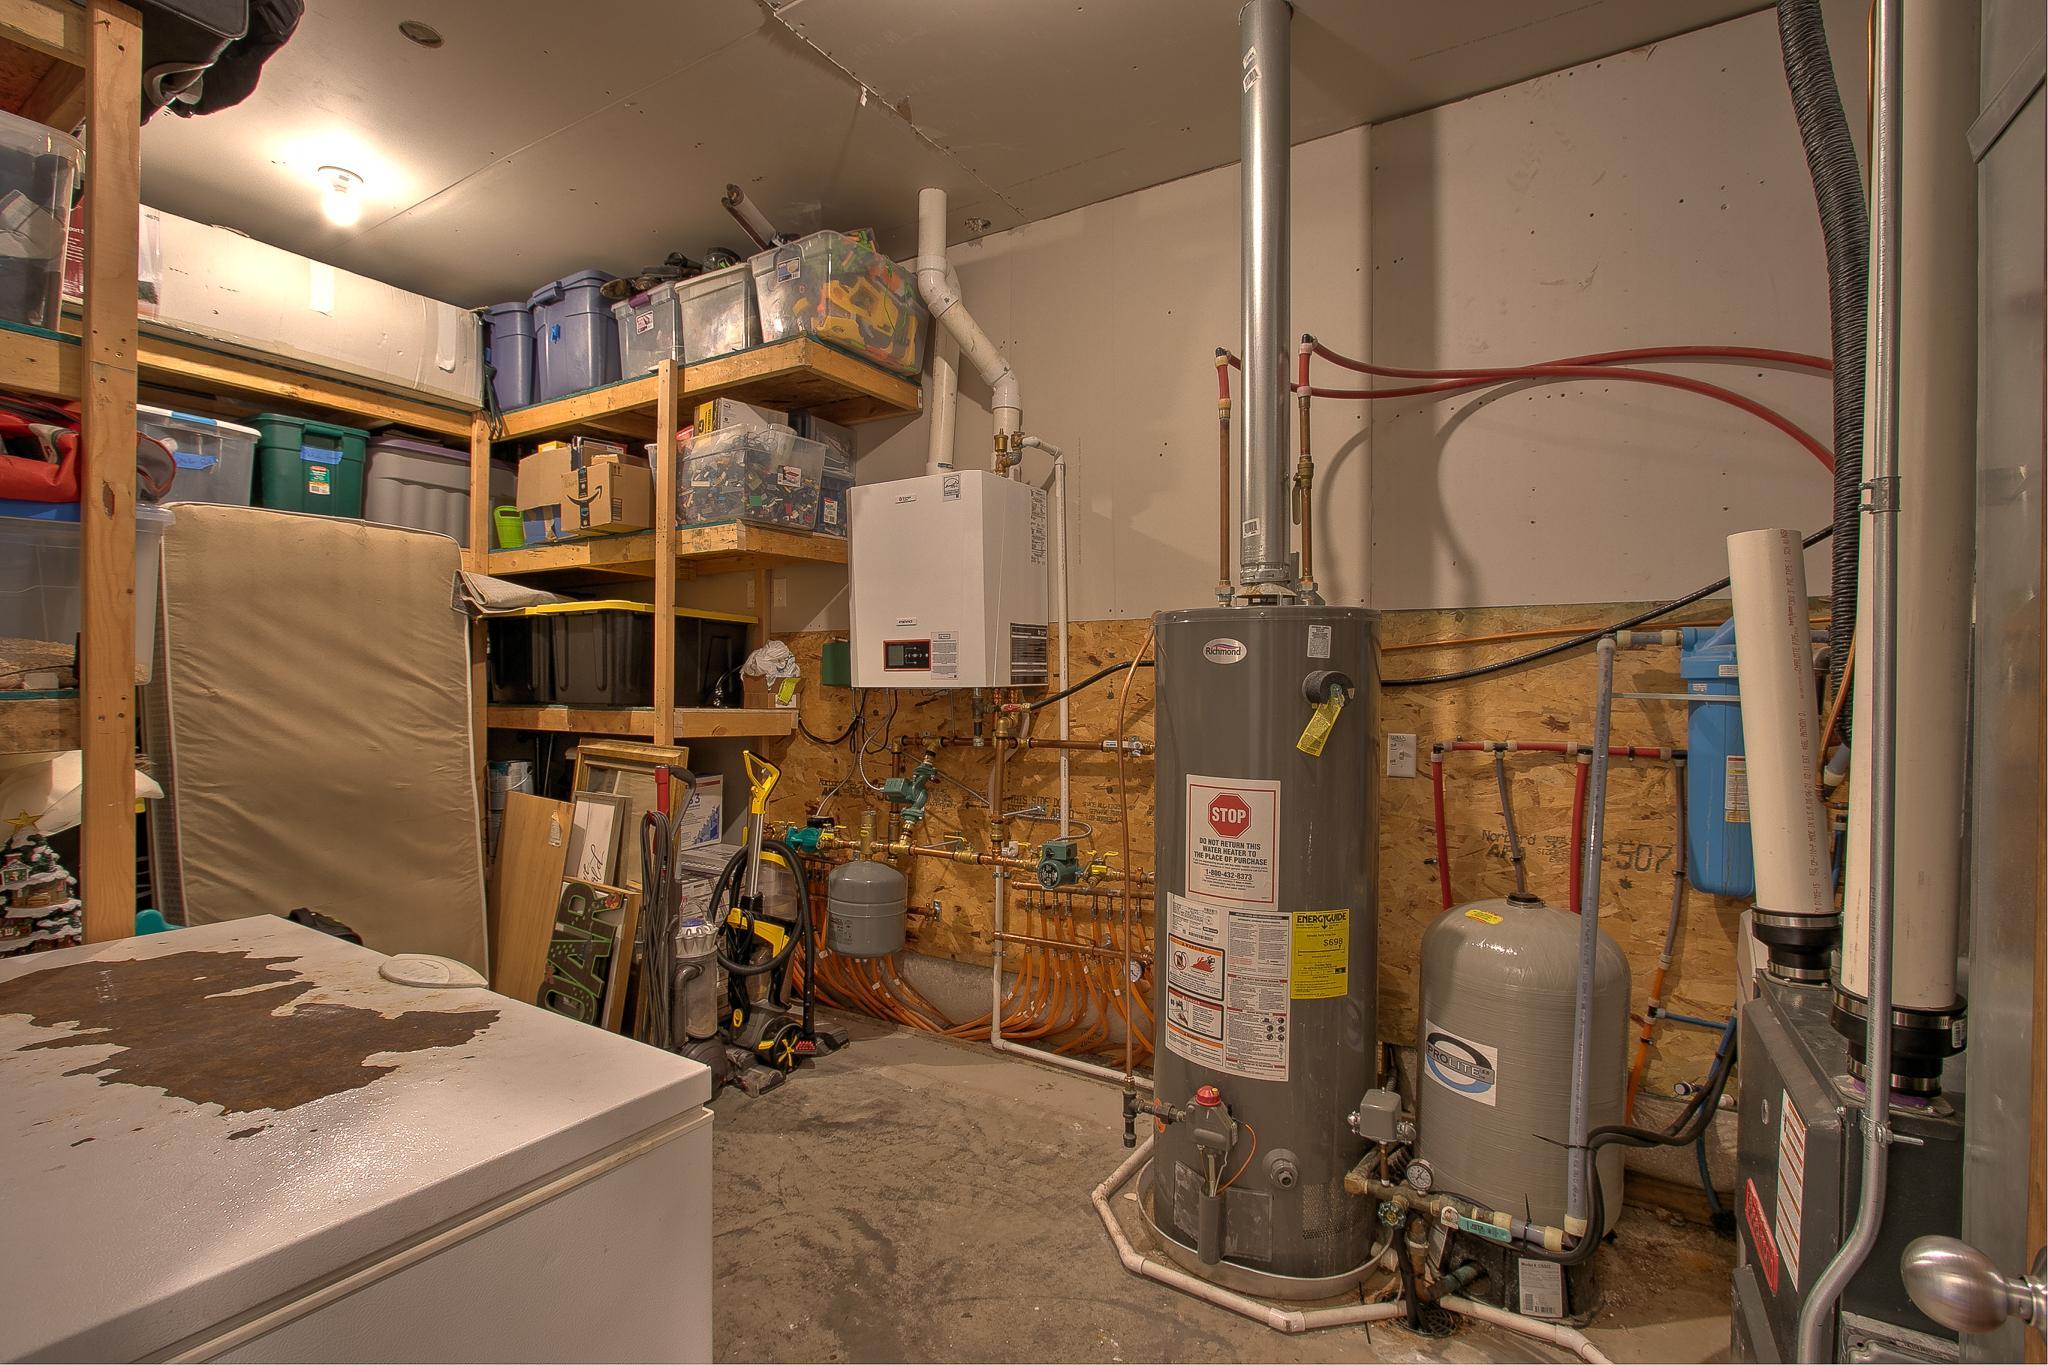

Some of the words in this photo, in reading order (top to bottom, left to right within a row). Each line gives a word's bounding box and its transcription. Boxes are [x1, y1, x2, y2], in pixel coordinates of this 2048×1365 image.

[1206, 647, 1241, 656] Richmond
[1211, 806, 1247, 824] STOP
[1202, 845, 1222, 854] WATER
[1223, 848, 1246, 857] HEATER
[1208, 838, 1218, 846] NOT
[1220, 840, 1244, 850] RETURN
[1246, 842, 1261, 850] THIS
[1194, 850, 1204, 858] THE
[1204, 853, 1222, 862] PLACE
[1234, 857, 1268, 866] PURCHASE
[1616, 843, 1673, 874] 507
[1427, 1044, 1480, 1076] PROLITE
